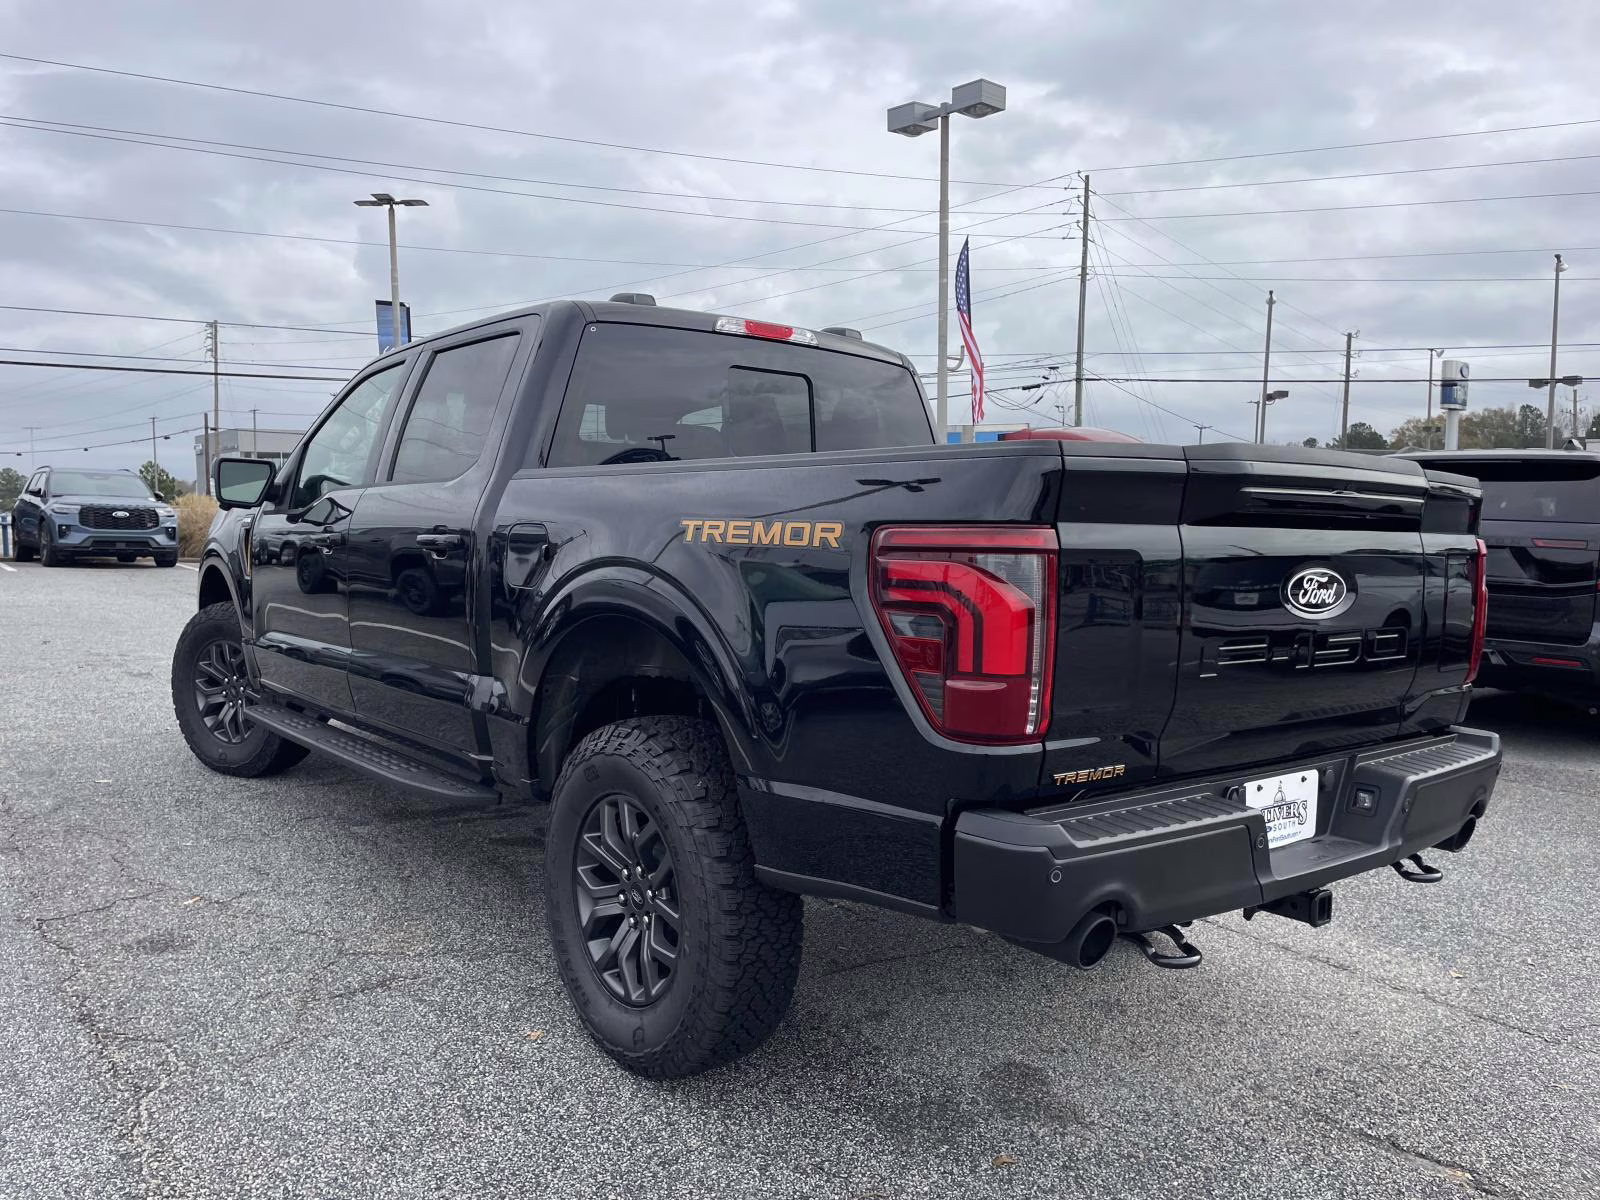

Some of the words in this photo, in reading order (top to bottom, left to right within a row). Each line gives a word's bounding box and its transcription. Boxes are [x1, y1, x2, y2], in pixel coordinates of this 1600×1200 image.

[680, 519, 843, 548] TREMOR
[1299, 575, 1337, 604] Ford
[1200, 627, 1408, 678] F-150
[1053, 764, 1126, 785] TREMOR
[1260, 799, 1308, 825] TIVERS
[1273, 820, 1296, 832] SOUTH
